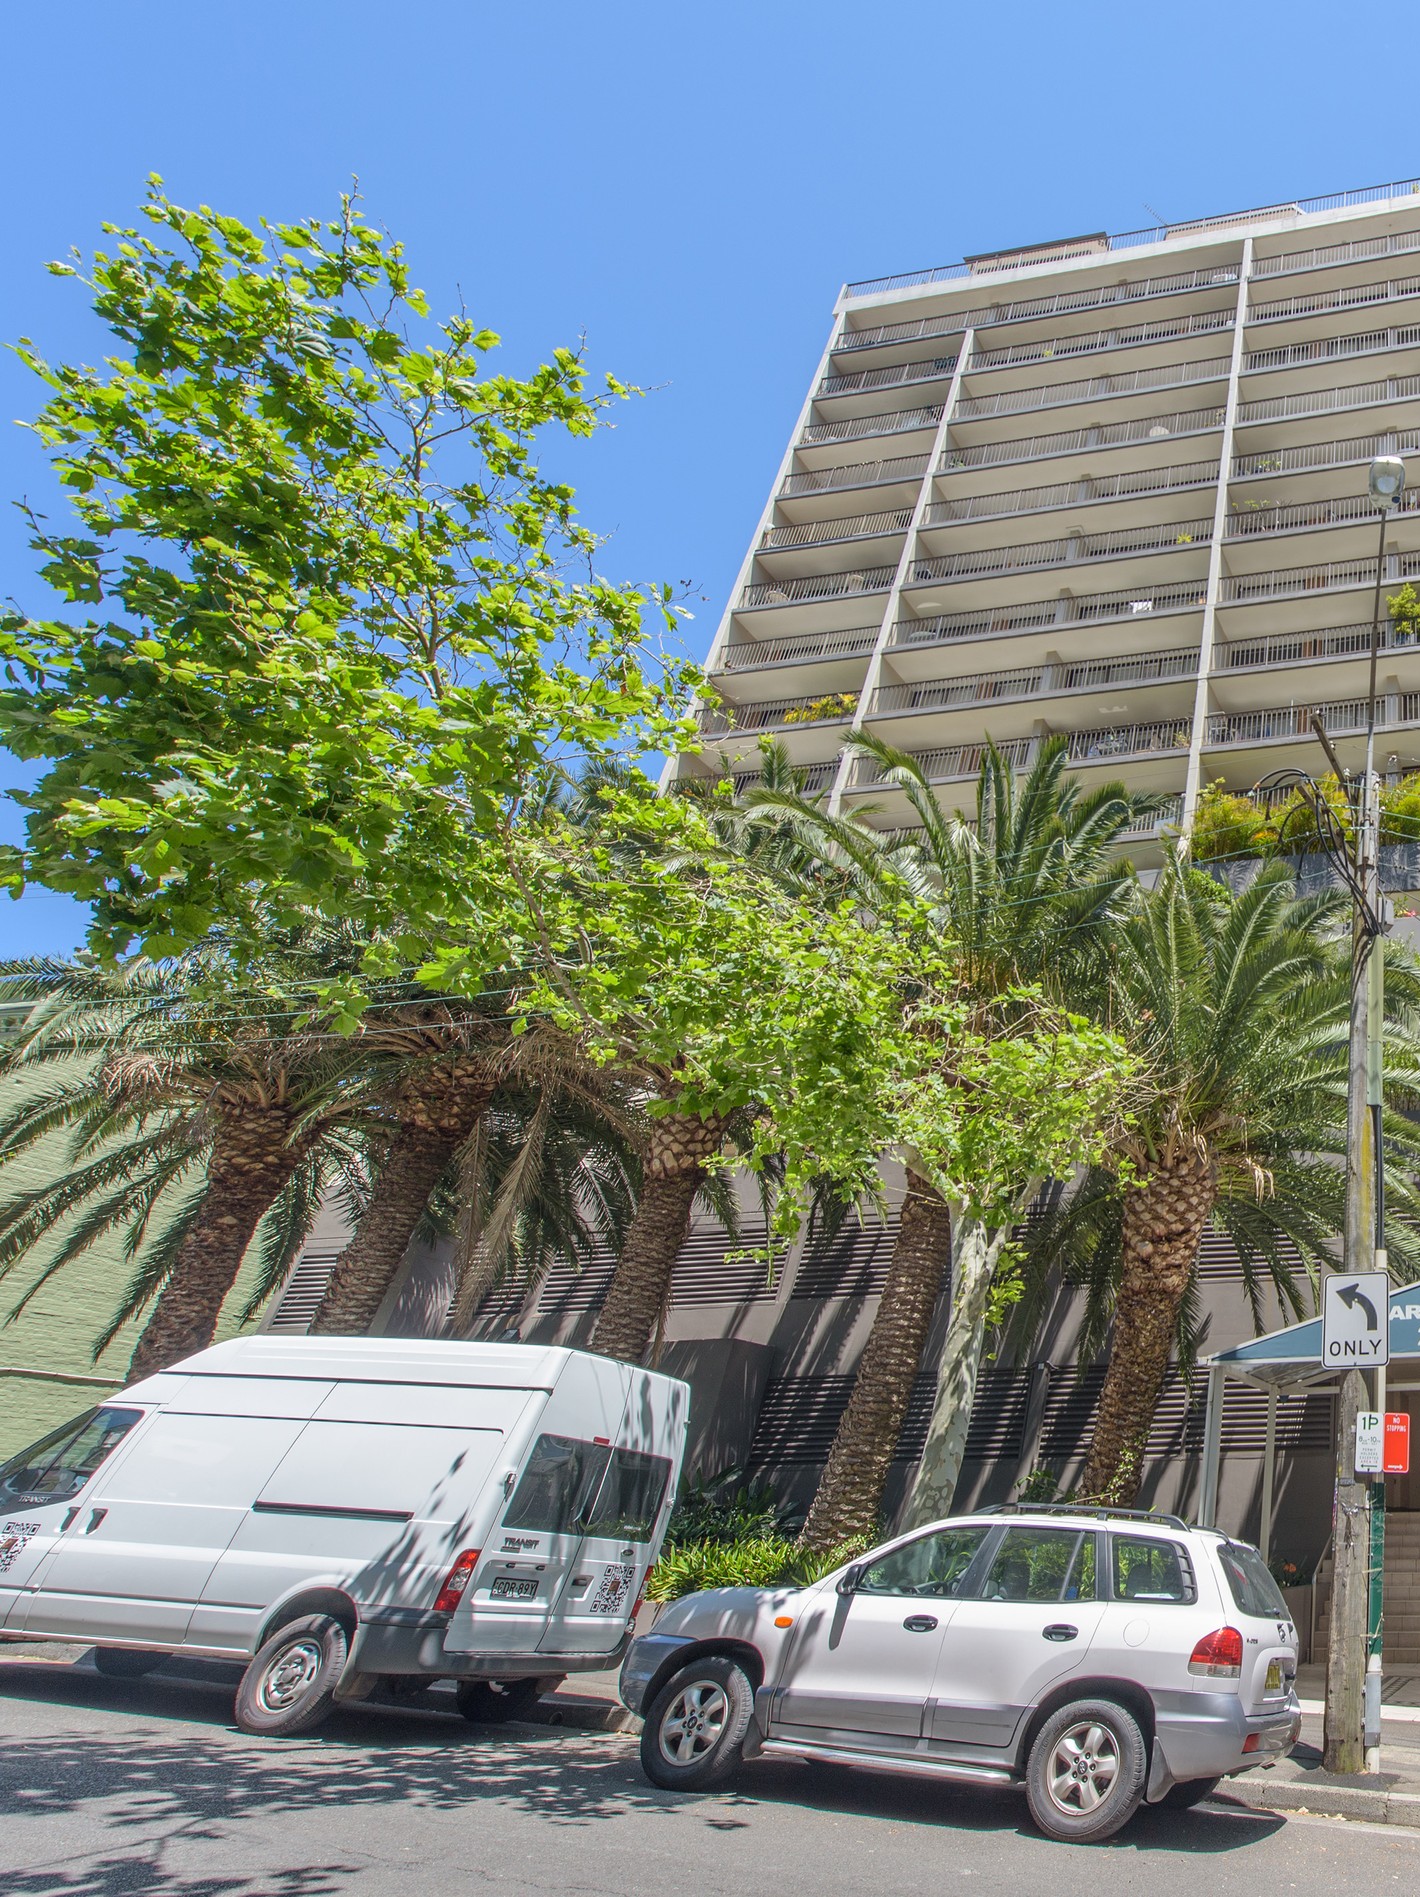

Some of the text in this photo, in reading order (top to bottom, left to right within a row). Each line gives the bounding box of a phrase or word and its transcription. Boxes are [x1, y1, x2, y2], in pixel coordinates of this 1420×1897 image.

[1329, 1339, 1382, 1357] ONLY
[1362, 1415, 1379, 1430] 1P
[19, 1495, 51, 1503] TRANSIT
[504, 1537, 540, 1550] TRANSIT
